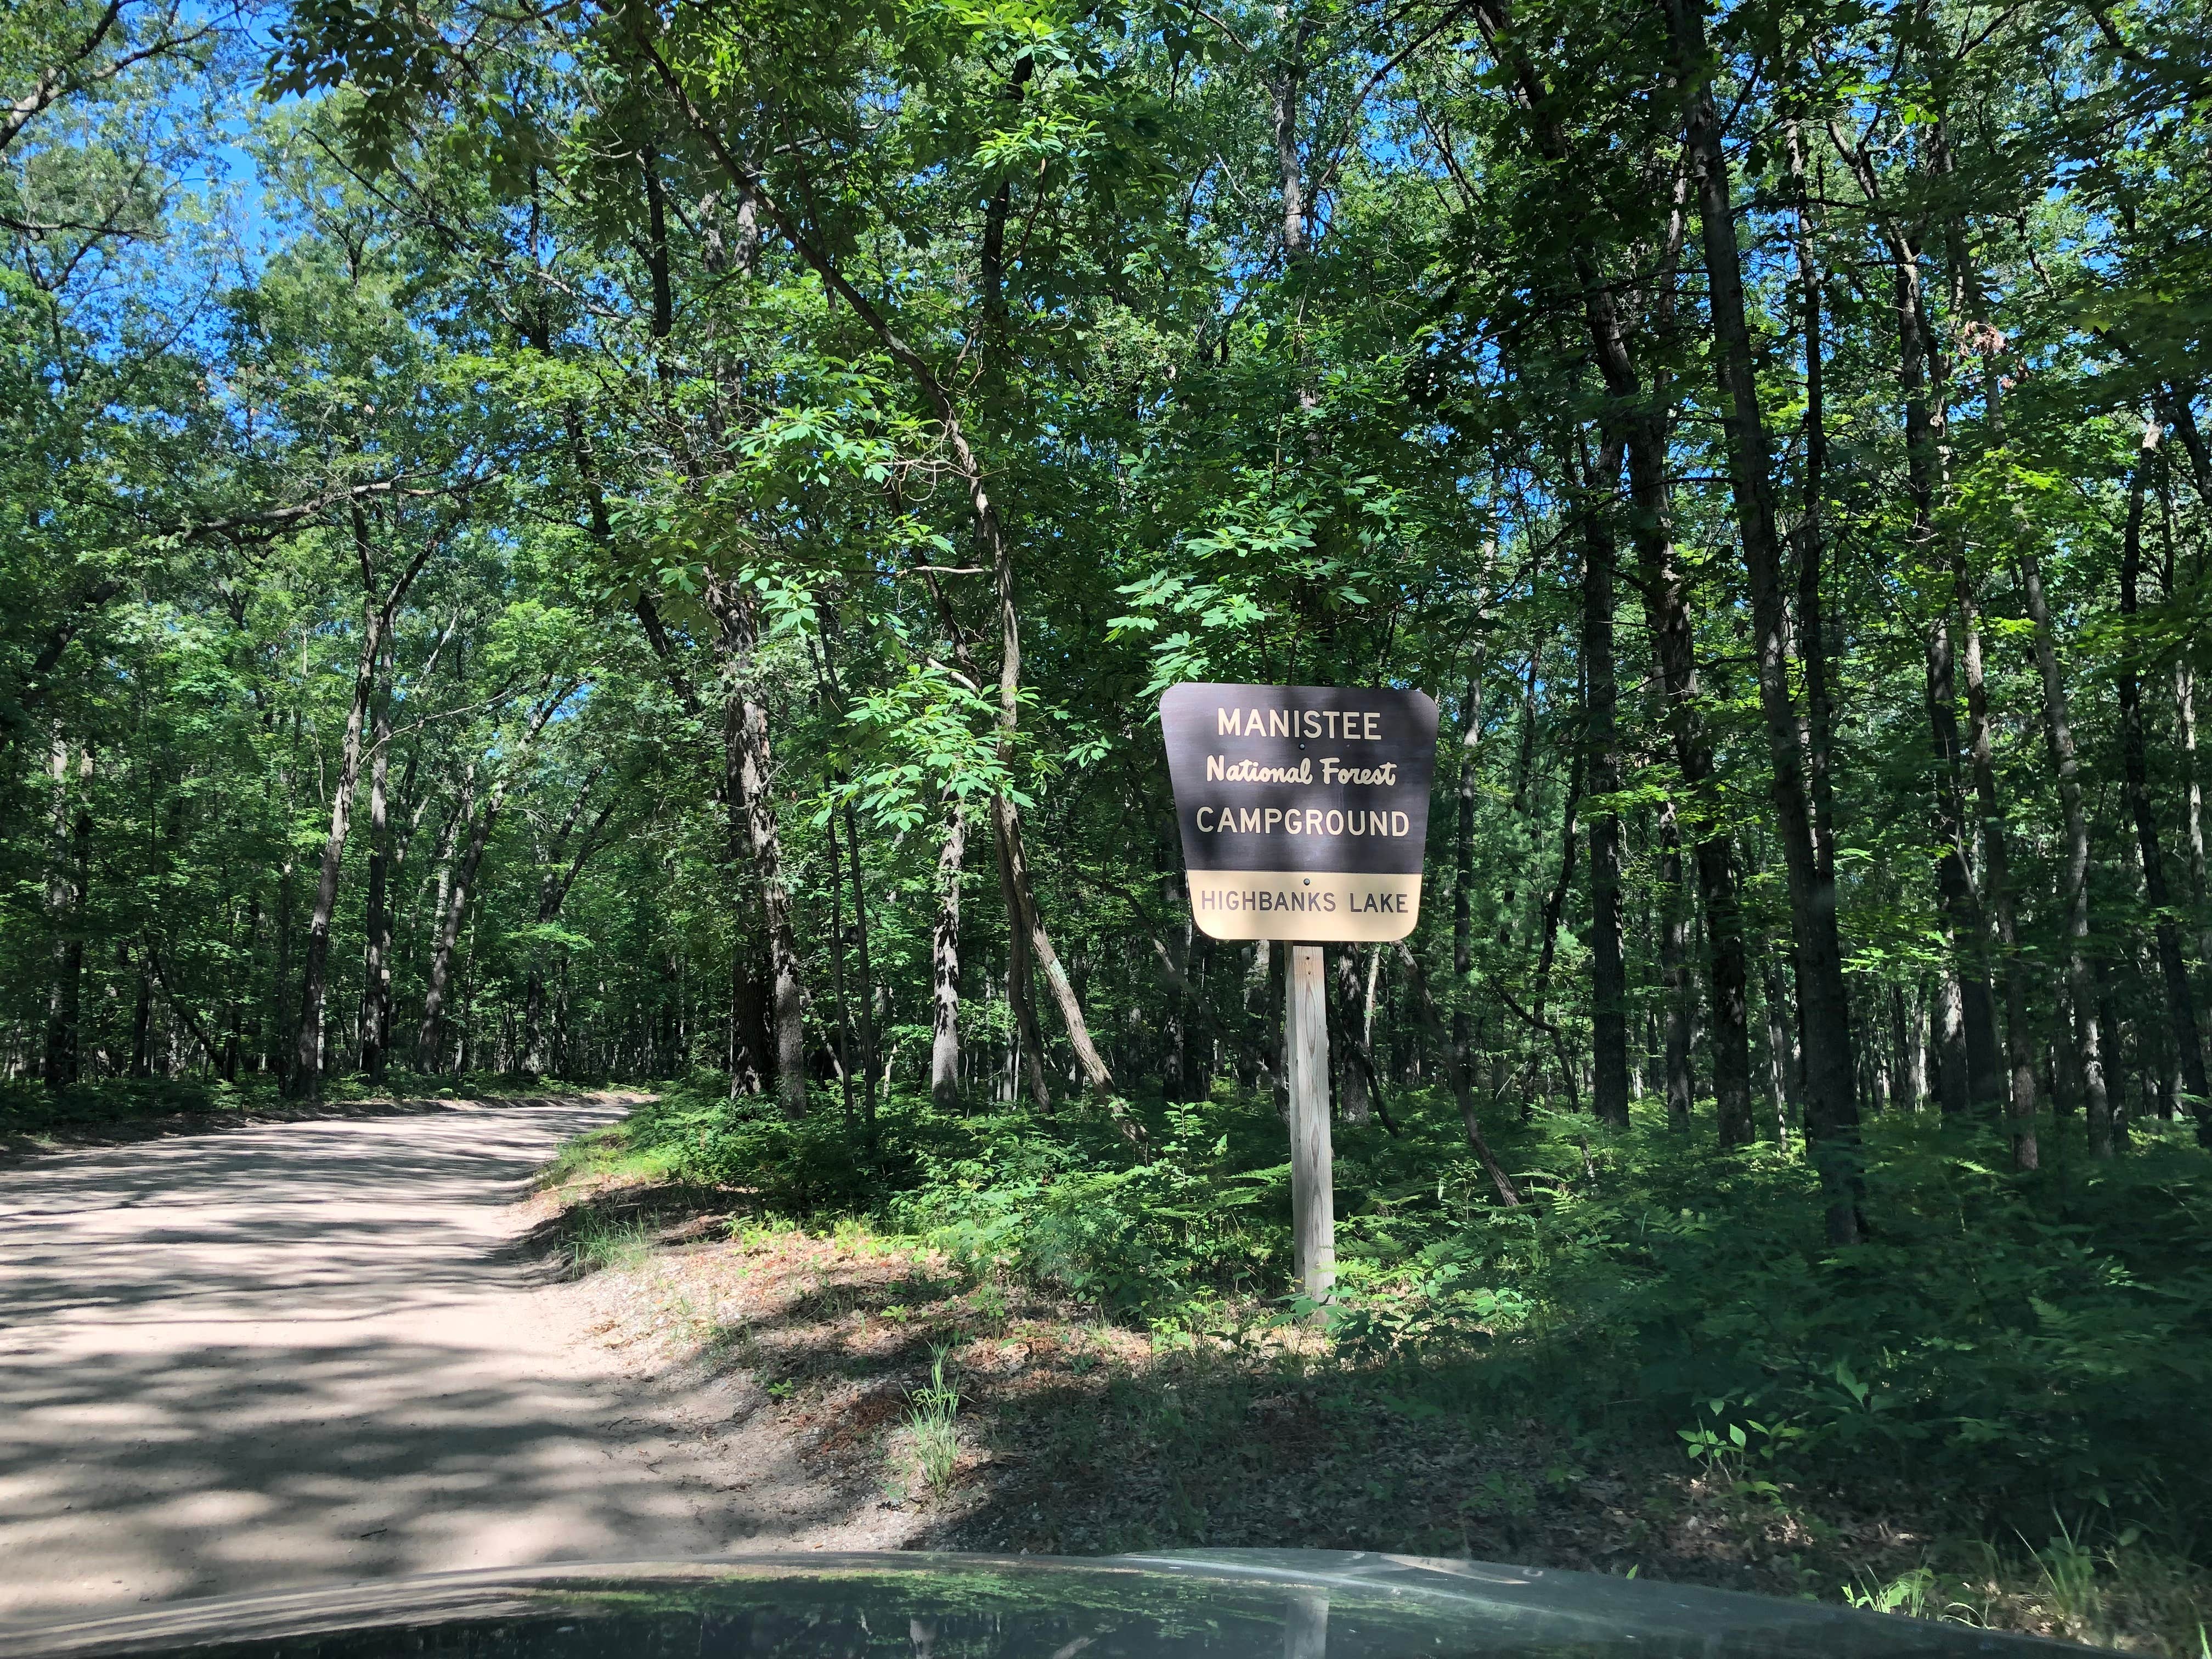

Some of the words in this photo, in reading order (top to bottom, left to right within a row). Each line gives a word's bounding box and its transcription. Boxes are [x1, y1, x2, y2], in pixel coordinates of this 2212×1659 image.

[1218, 708, 1382, 740] MANISTEE
[1206, 755, 1313, 785] National
[1319, 757, 1397, 786] Forest
[1196, 806, 1409, 837] CAMPGROUND
[1201, 890, 1336, 912] HIGHBANKS
[1350, 893, 1409, 913] LAKE
